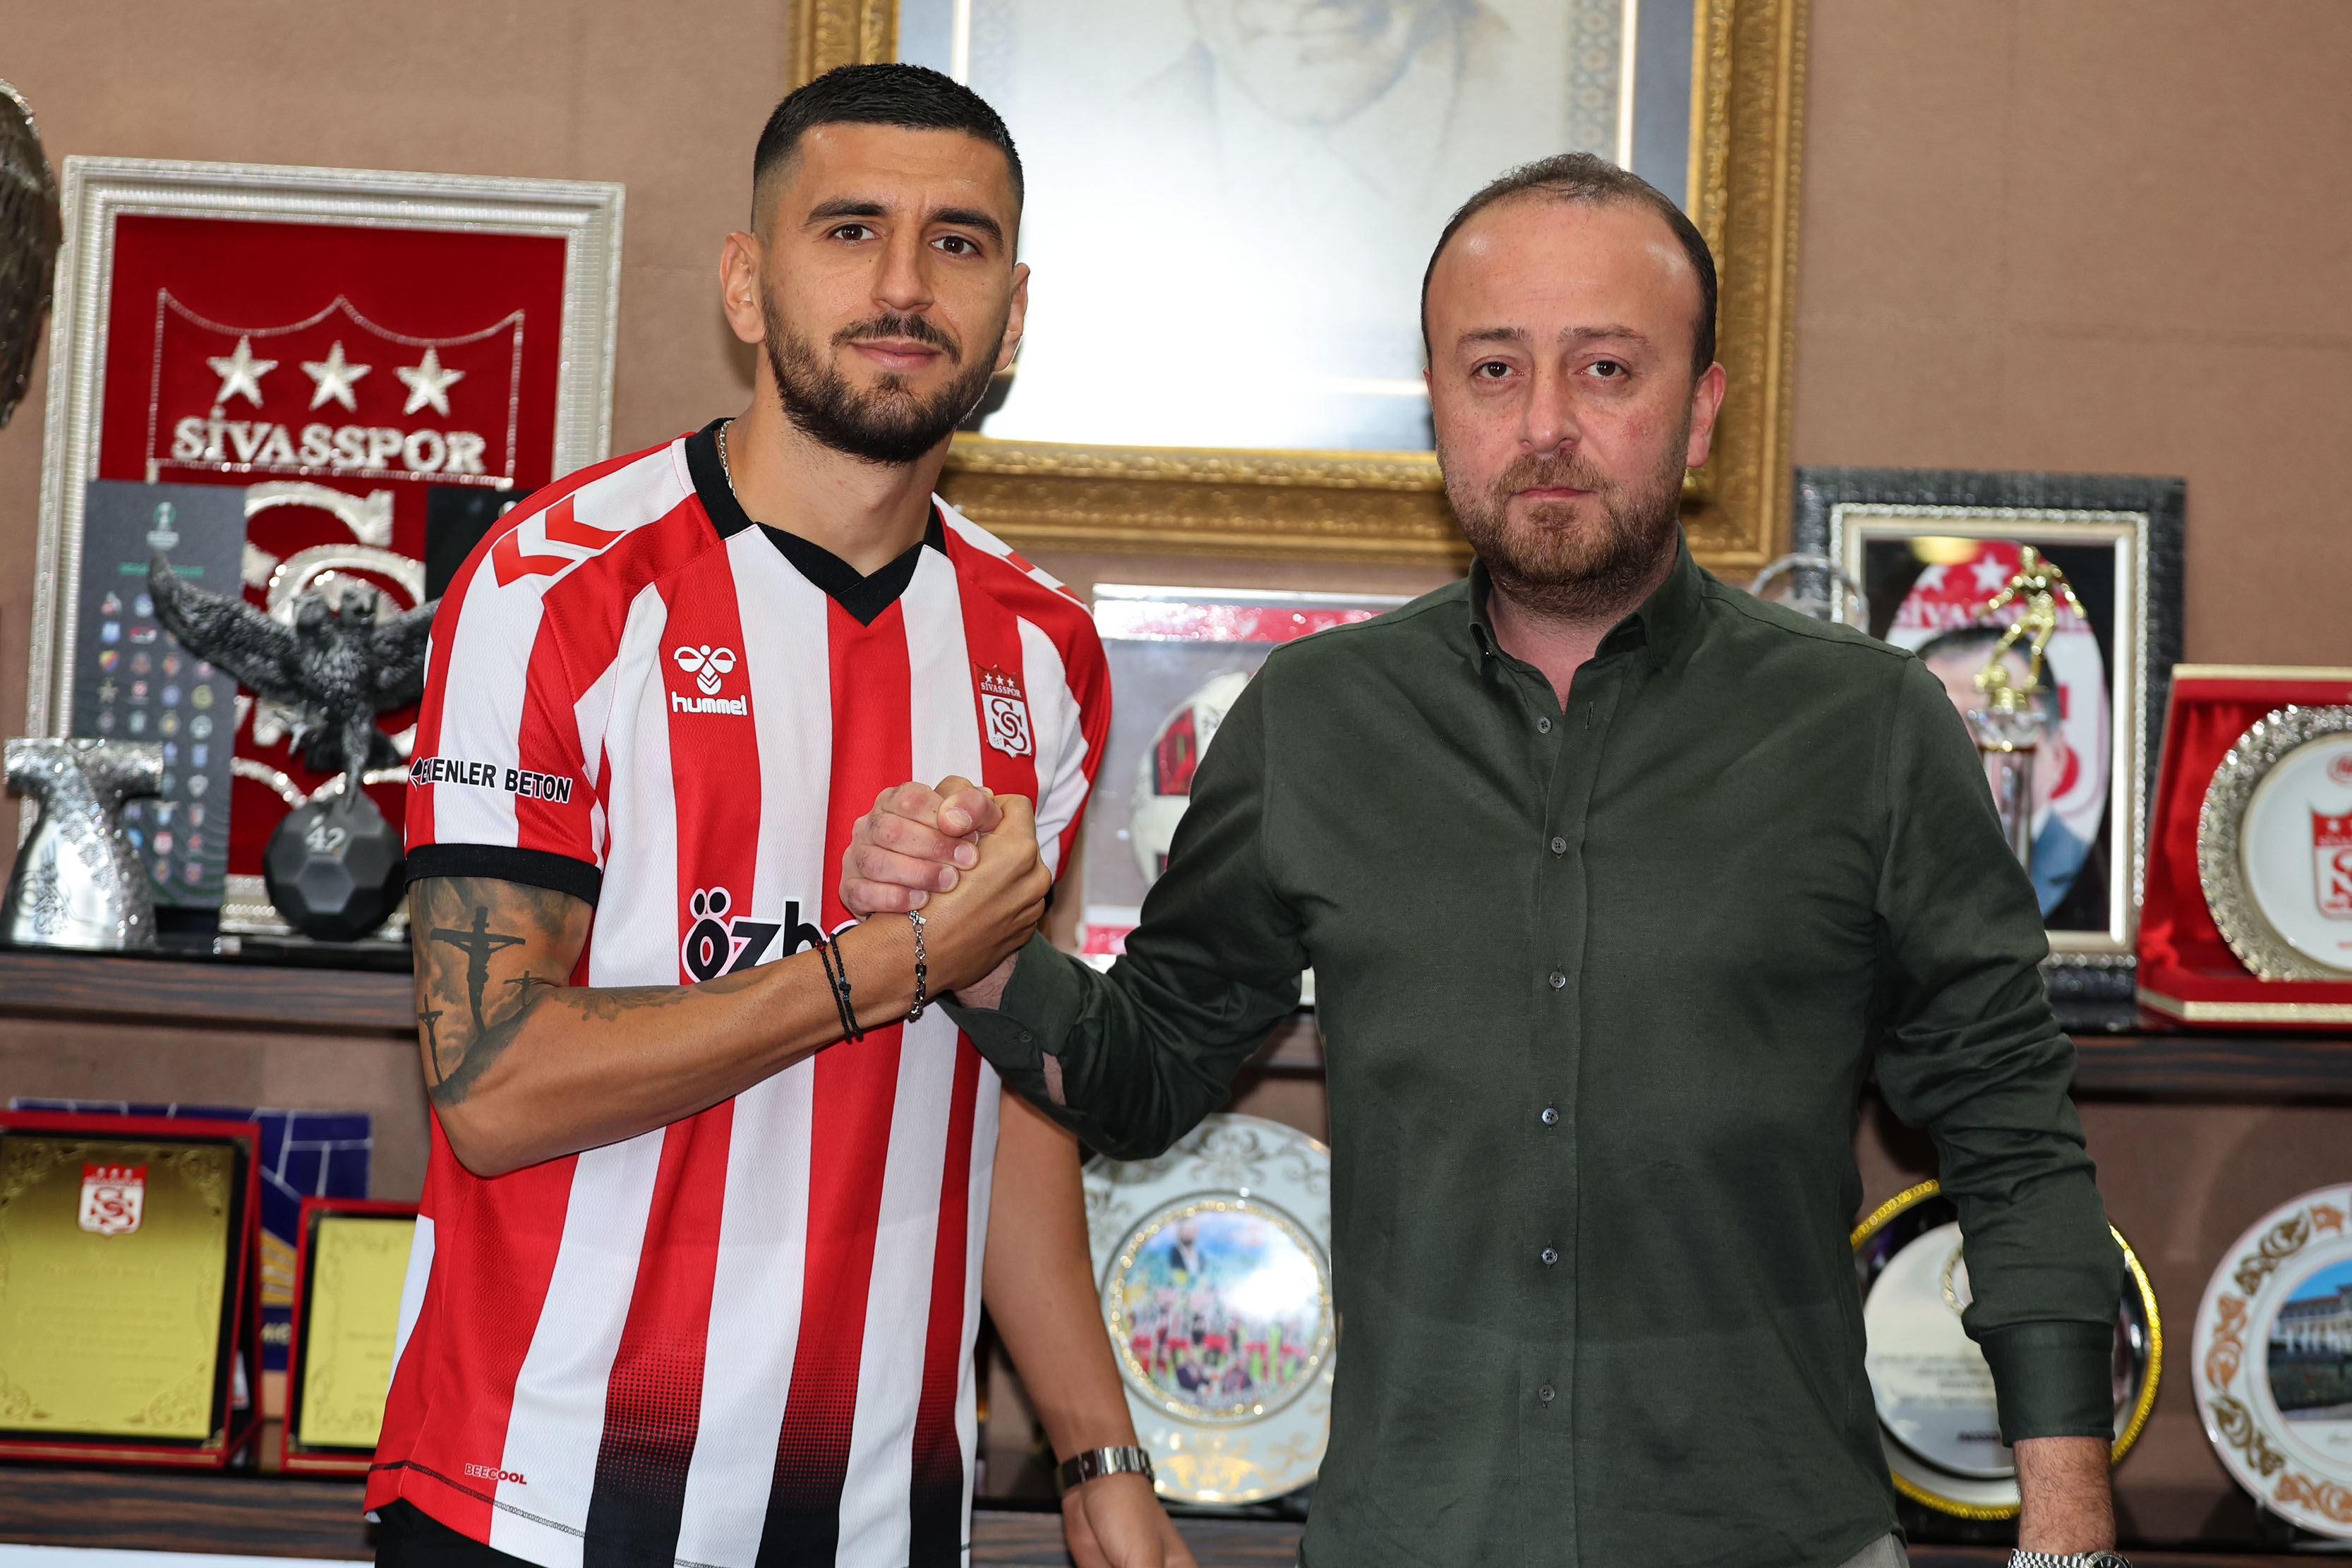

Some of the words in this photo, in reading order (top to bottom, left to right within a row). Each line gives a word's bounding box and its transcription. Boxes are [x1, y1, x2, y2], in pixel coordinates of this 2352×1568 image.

[172, 406, 487, 474] SİVASSPOR
[671, 691, 748, 716] hummel
[505, 767, 573, 804] BETON
[305, 824, 346, 852] 42
[464, 1463, 527, 1485] BEECOOL
